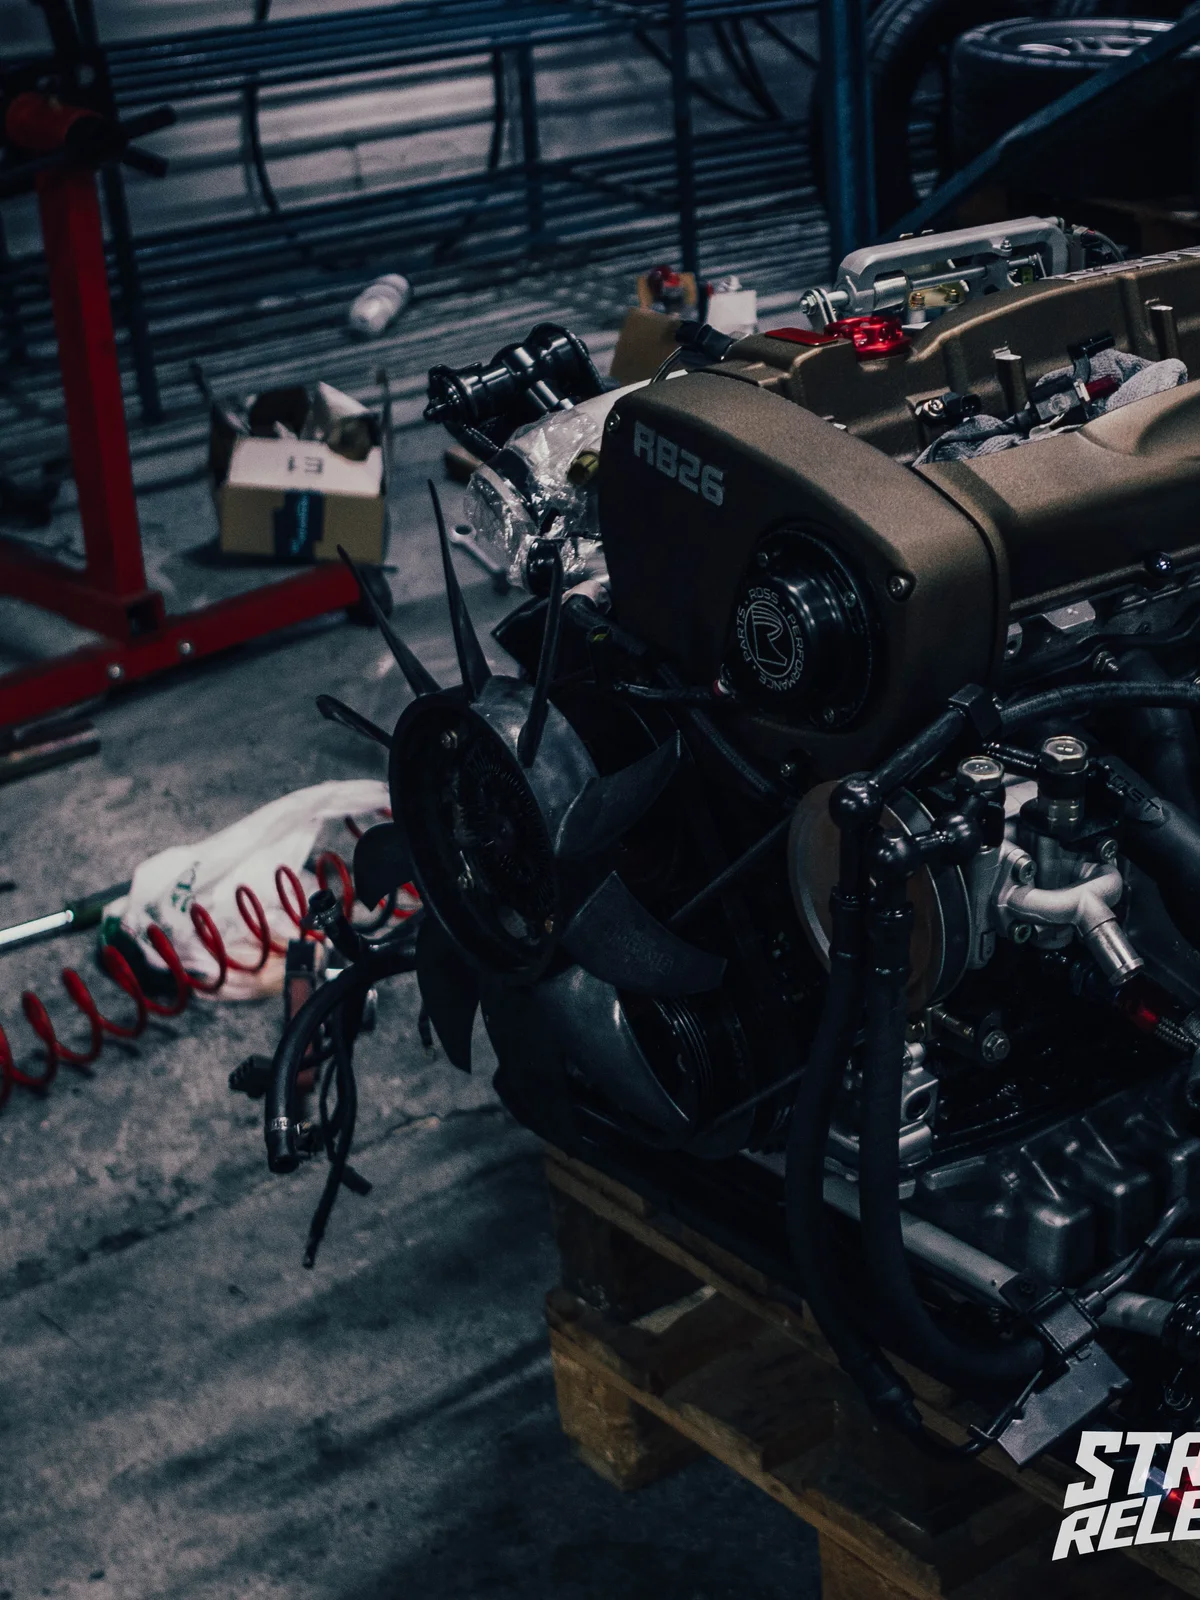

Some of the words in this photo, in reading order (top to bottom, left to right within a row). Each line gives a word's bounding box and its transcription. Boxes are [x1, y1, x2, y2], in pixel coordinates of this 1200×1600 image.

[634, 419, 724, 506] RB26
[748, 587, 779, 604] ROSS
[736, 605, 752, 662] PARTS
[759, 613, 804, 691] PERFORMANCE
